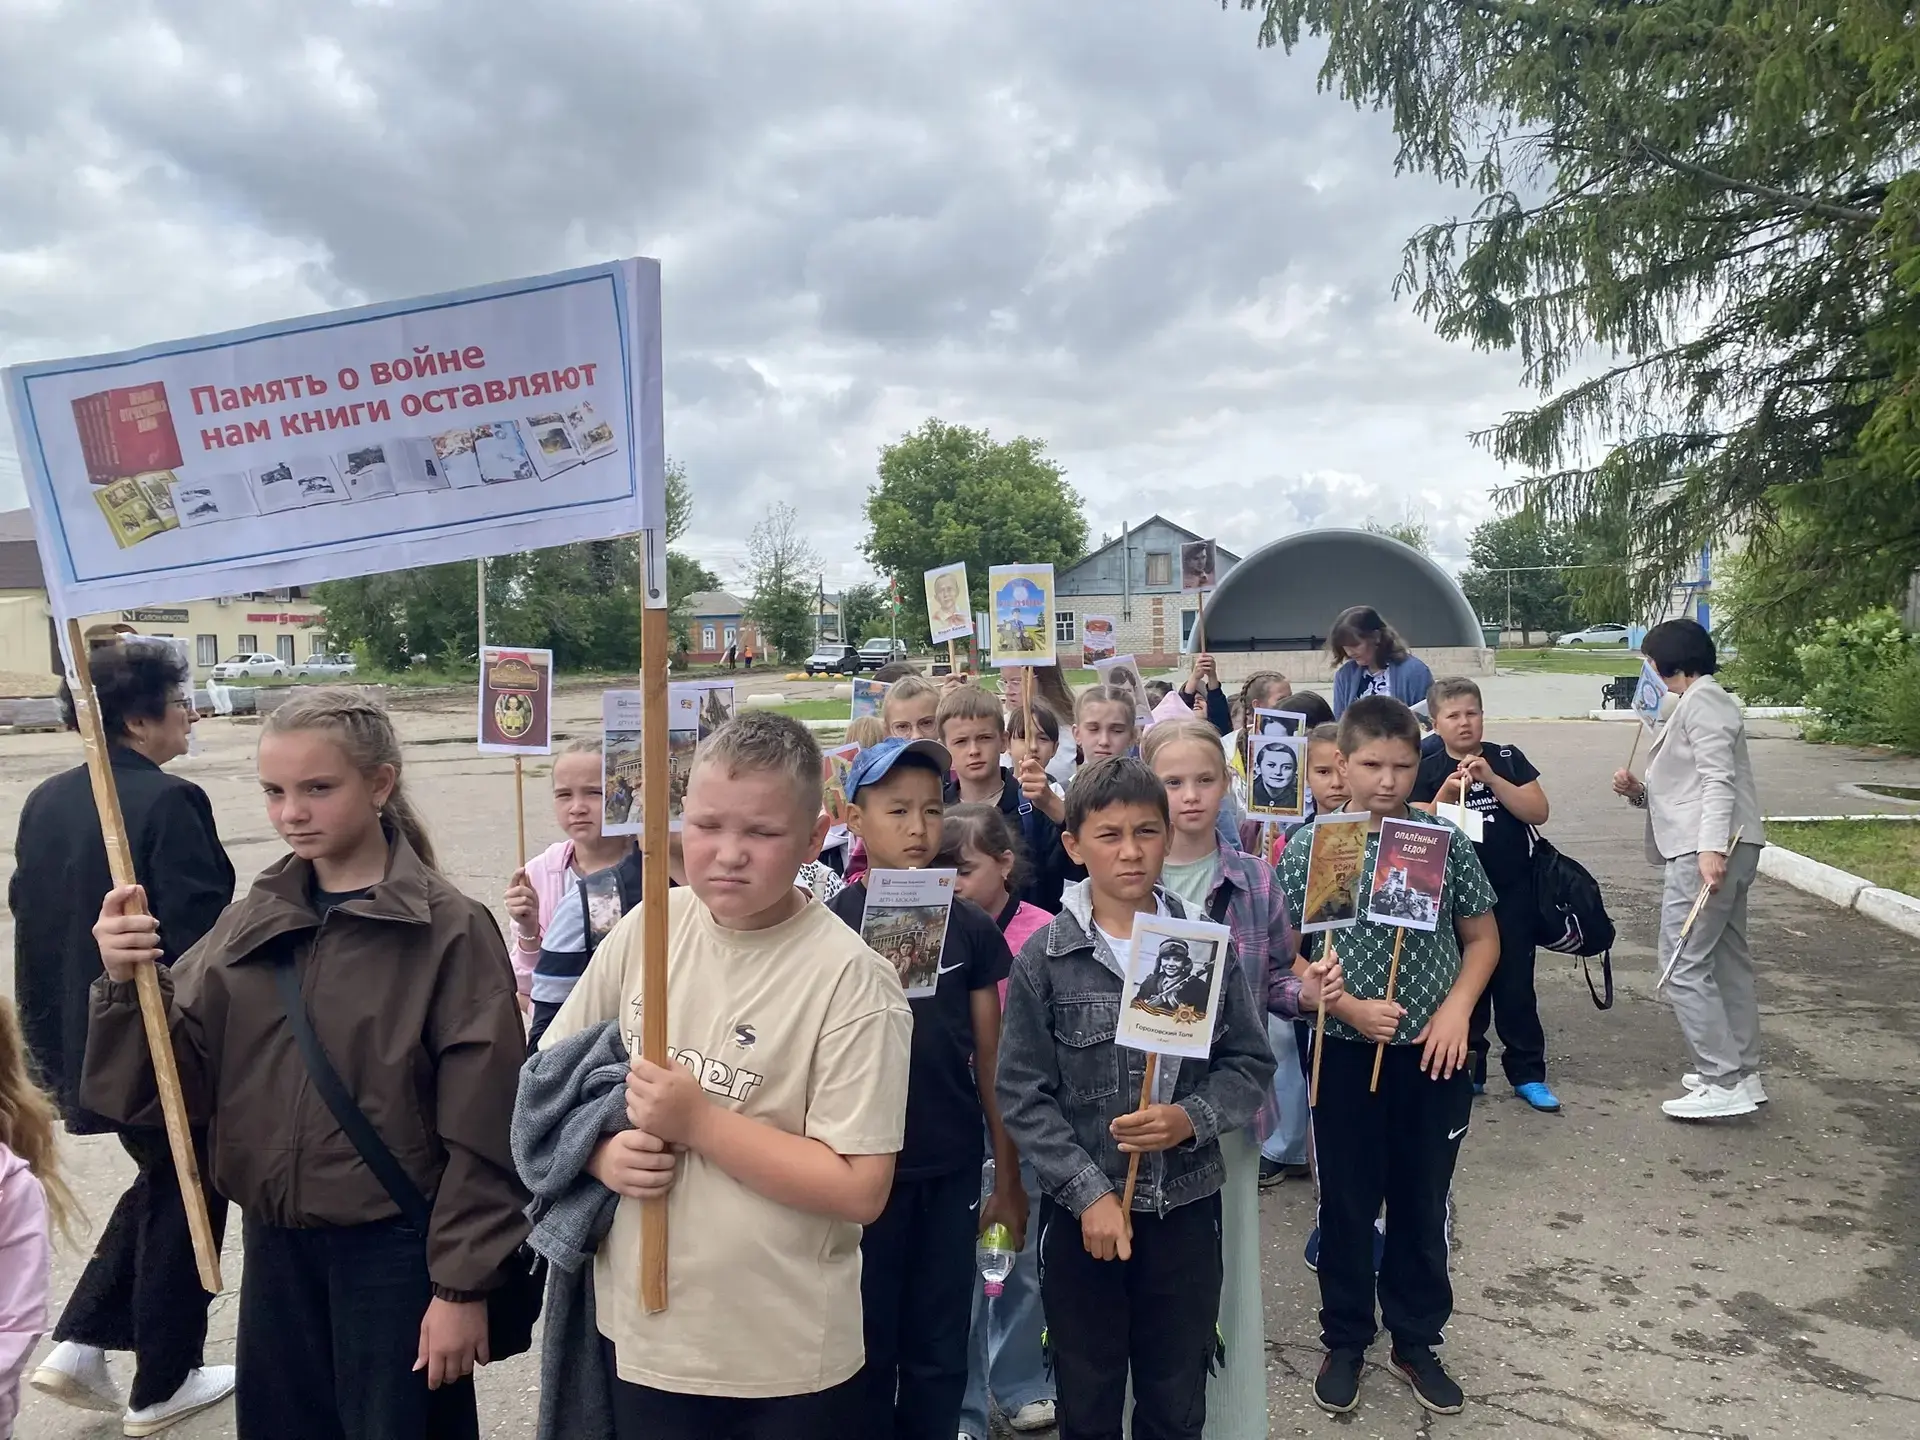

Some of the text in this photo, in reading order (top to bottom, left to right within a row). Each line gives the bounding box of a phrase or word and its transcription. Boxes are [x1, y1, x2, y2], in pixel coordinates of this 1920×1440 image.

[189, 374, 328, 415] Память
[337, 368, 360, 390] о
[370, 345, 485, 385] войне
[200, 363, 597, 450] нам книги оставляют
[1394, 831, 1439, 845] ОПАЛЁННЫЕ
[1402, 844, 1428, 855] БЕДОЙ
